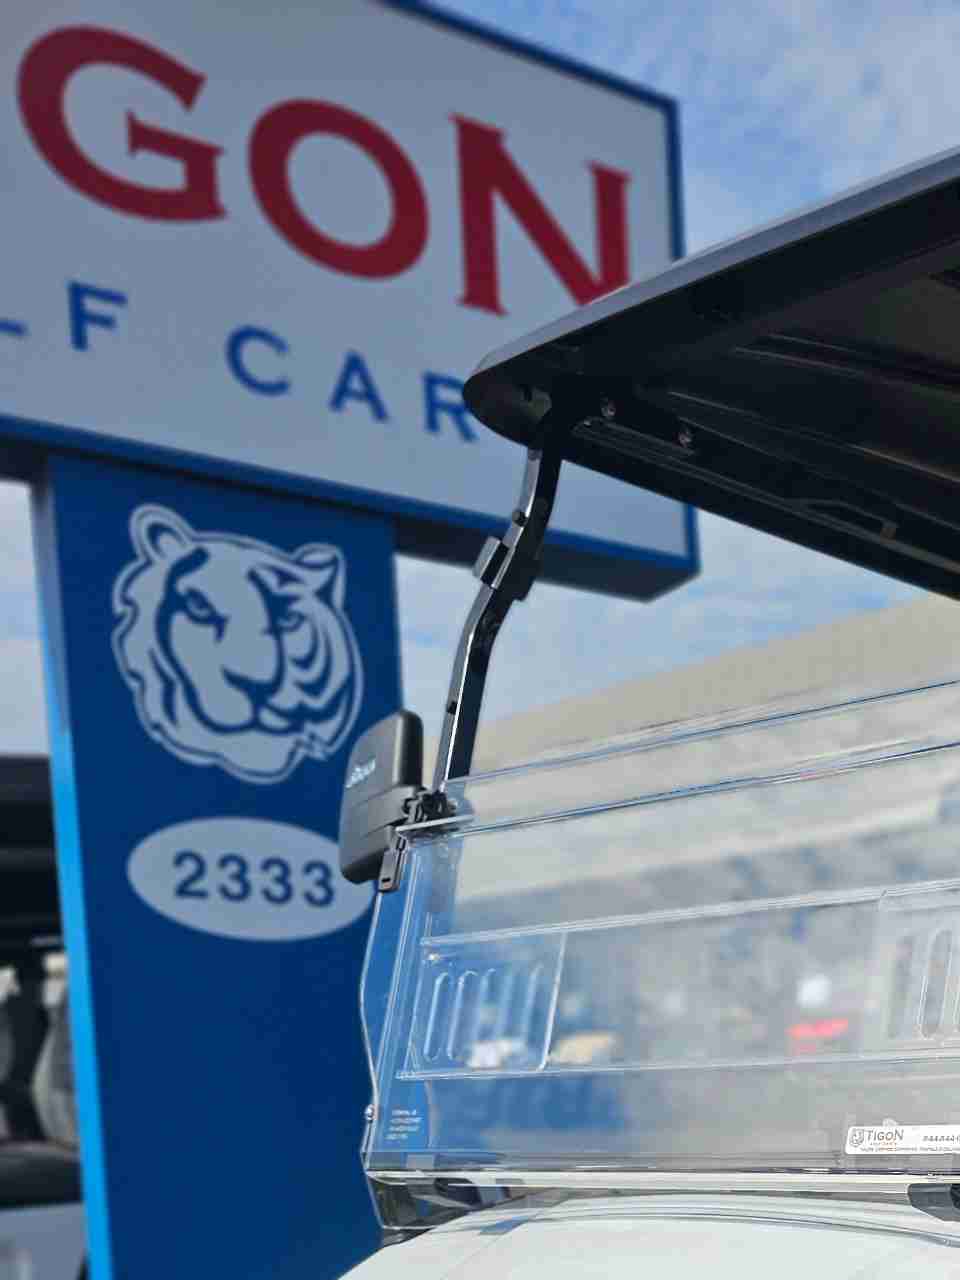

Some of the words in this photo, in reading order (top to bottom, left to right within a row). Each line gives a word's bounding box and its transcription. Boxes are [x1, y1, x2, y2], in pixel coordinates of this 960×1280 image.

[17, 24, 632, 317] GON
[0, 279, 128, 352] F
[172, 850, 335, 907] 2333
